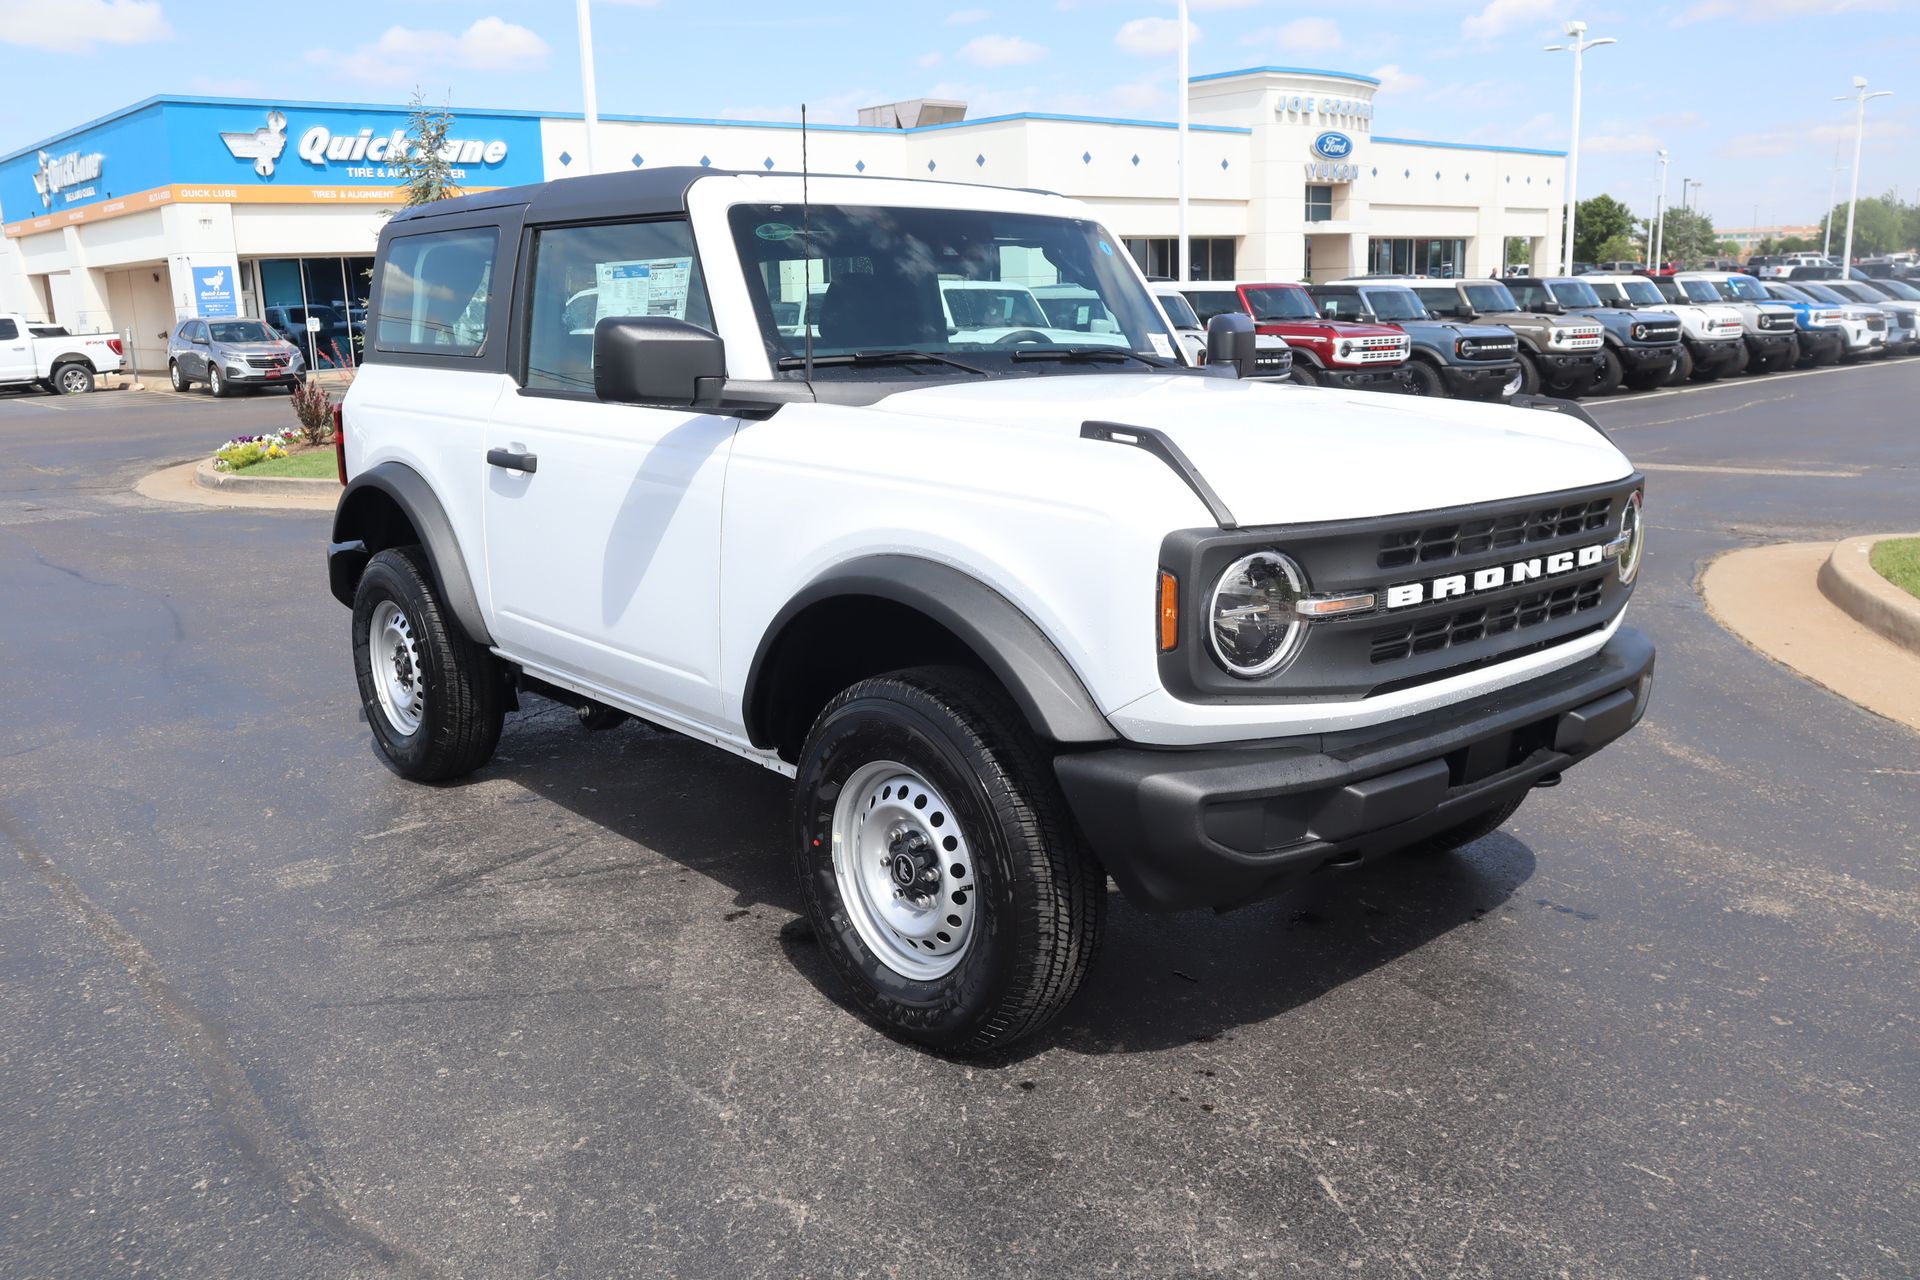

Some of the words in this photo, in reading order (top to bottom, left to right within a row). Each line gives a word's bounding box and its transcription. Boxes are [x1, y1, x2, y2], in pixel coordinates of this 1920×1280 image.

[298, 126, 414, 164] Quick
[1323, 136, 1347, 153] Ford
[346, 167, 374, 178] TIRE
[376, 168, 386, 178] &
[1308, 162, 1359, 180] YUKON
[181, 189, 210, 198] QUICK
[212, 189, 237, 198] LUBE
[312, 190, 336, 198] TIRES
[347, 190, 394, 199] ALIGNMENT
[1387, 544, 1603, 609] BRONCO
